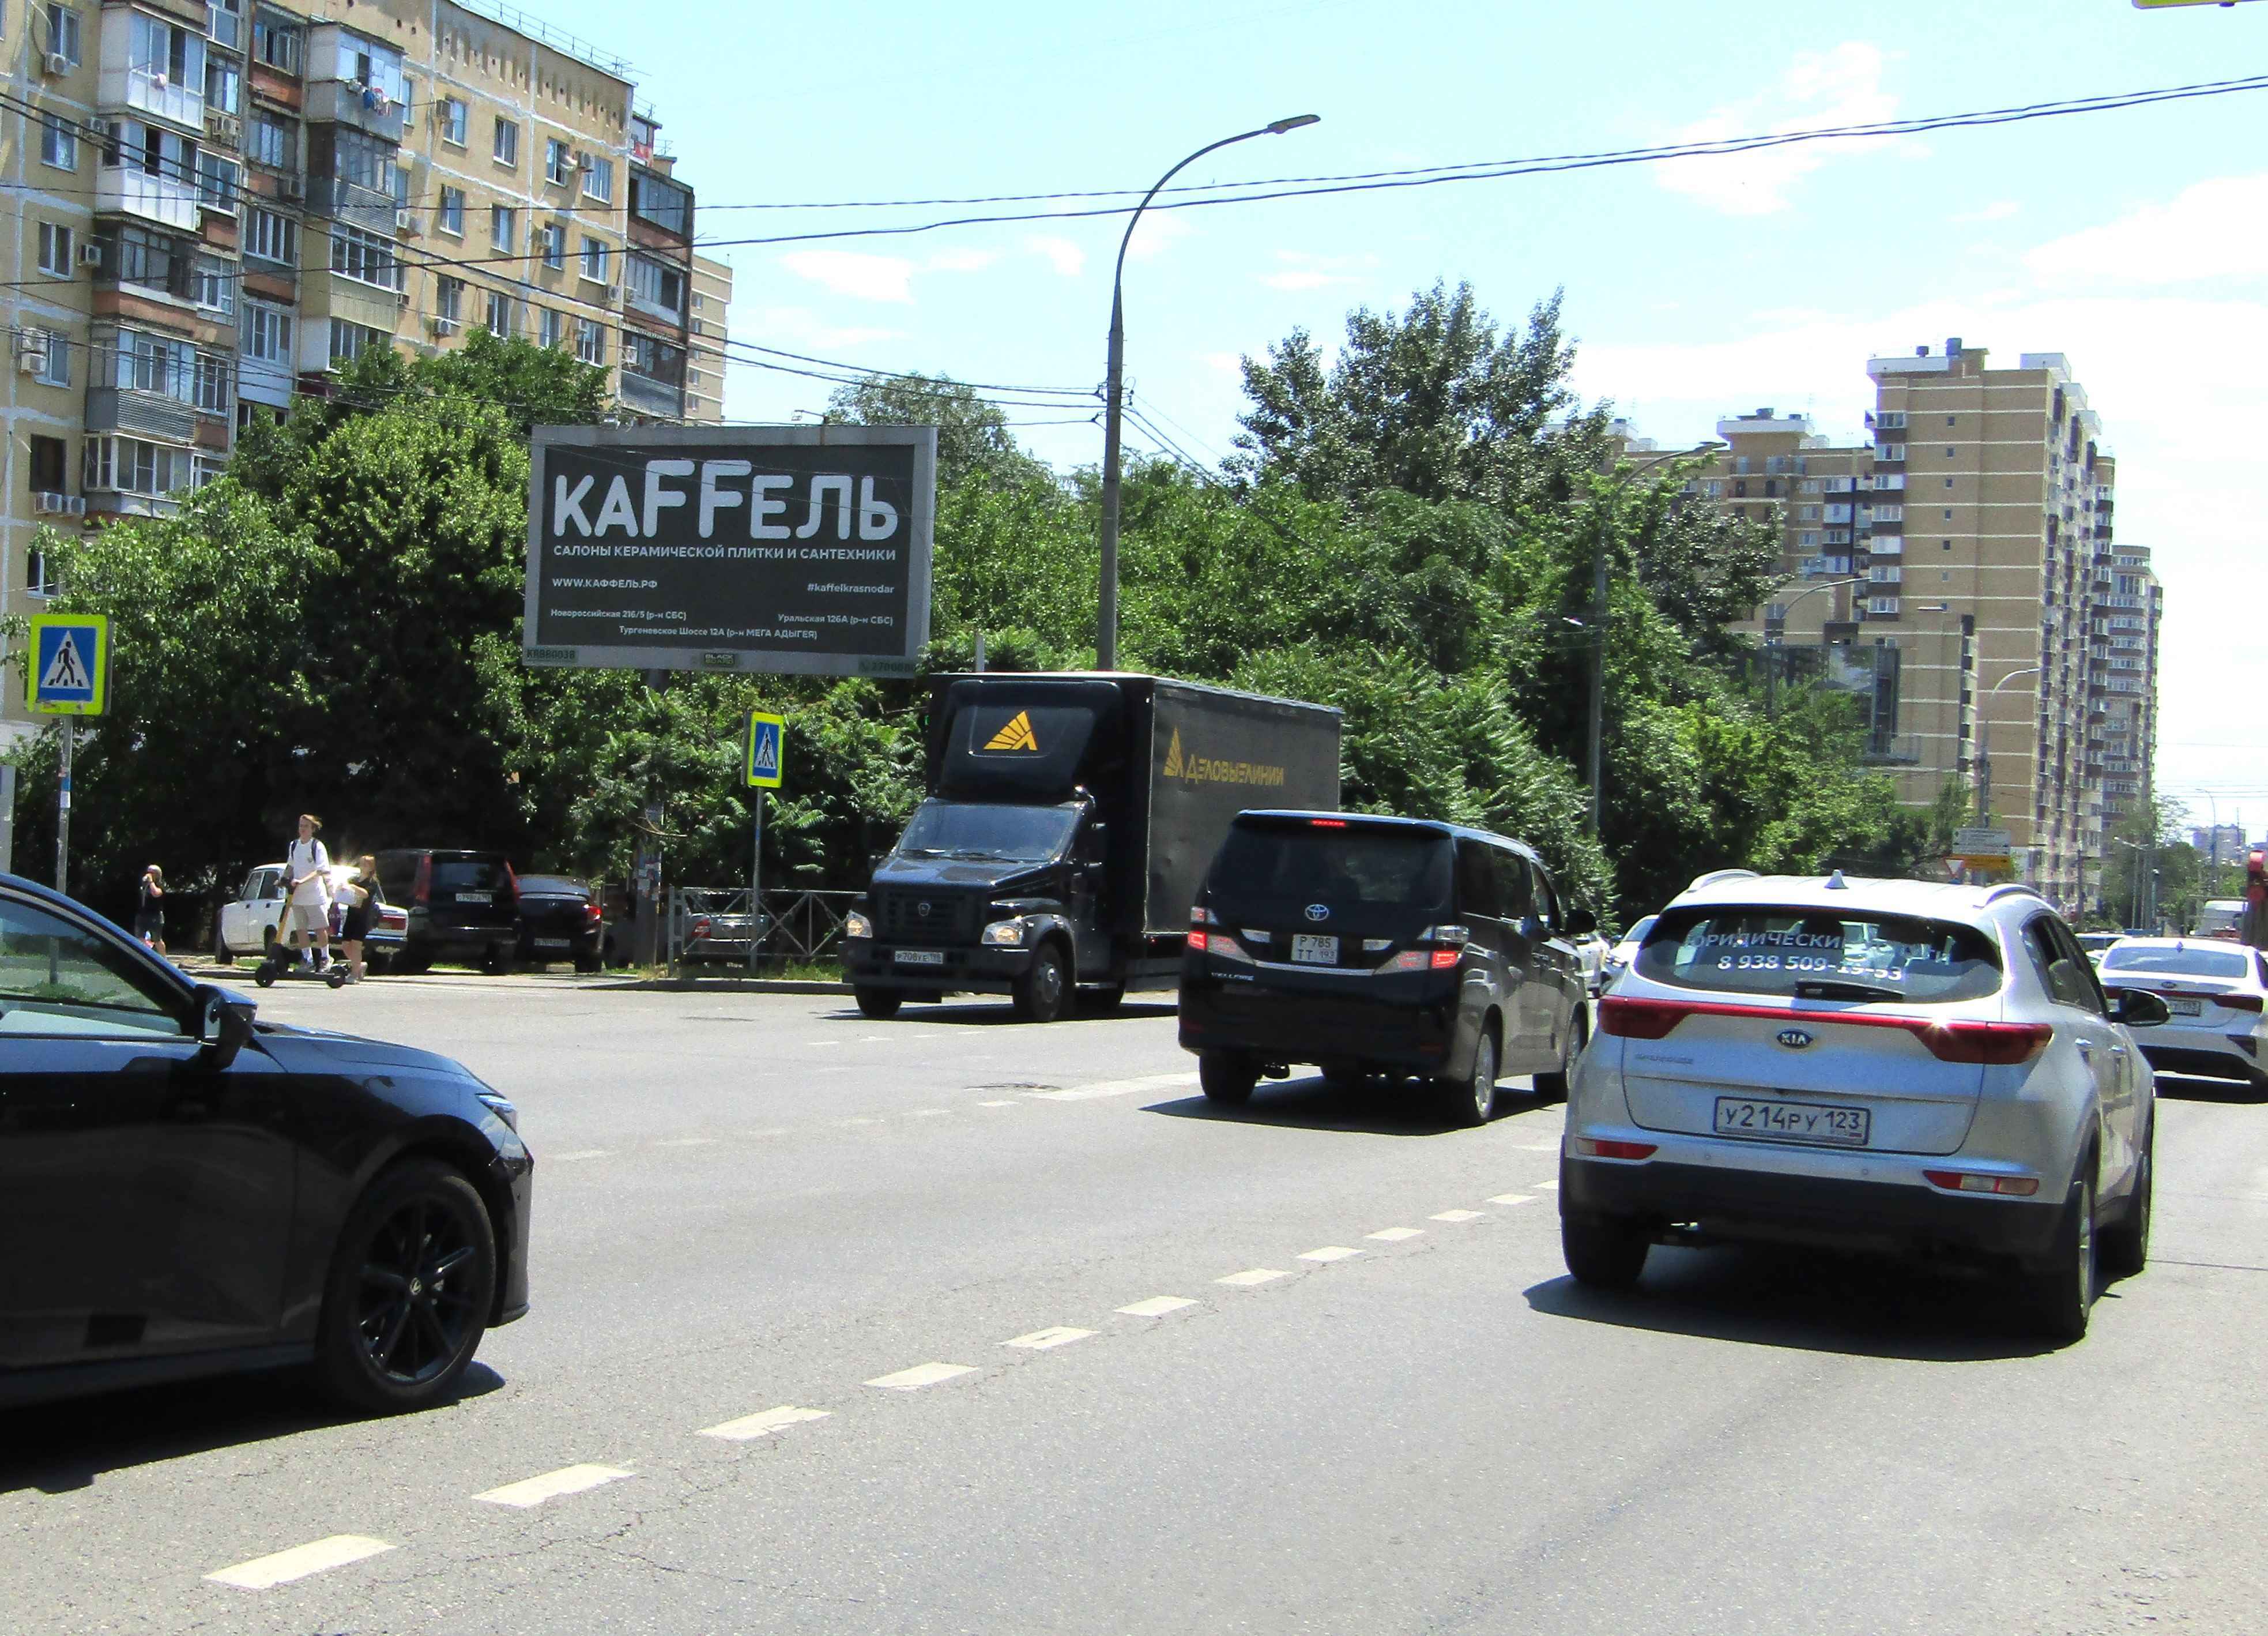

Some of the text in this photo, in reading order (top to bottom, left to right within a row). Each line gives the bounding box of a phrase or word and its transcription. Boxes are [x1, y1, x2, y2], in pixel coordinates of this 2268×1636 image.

[553, 544, 896, 561] САЛОНЫ КЕРАМИЧЕСКОЙ ПЛИТКИ И САНТЕХНИКИ
[552, 578, 658, 589] WWW.КАФФЕЛЬ.РФ
[807, 582, 895, 594] #kaffelkrasnodar
[550, 608, 620, 619] Новороссийская
[621, 610, 645, 619] 216/5
[778, 613, 825, 623] Уральская
[619, 626, 677, 635] Тургеневское
[679, 627, 708, 635] Шоссе
[746, 628, 772, 638] МЕГА
[774, 629, 817, 640] АДЫГЕЯ)
[1298, 949, 1313, 960] ТТ
[1717, 954, 1732, 970] 8
[1737, 954, 1780, 970] 938
[1781, 1033, 1807, 1045] KIA
[1726, 1104, 1862, 1131] У214РУ 123
